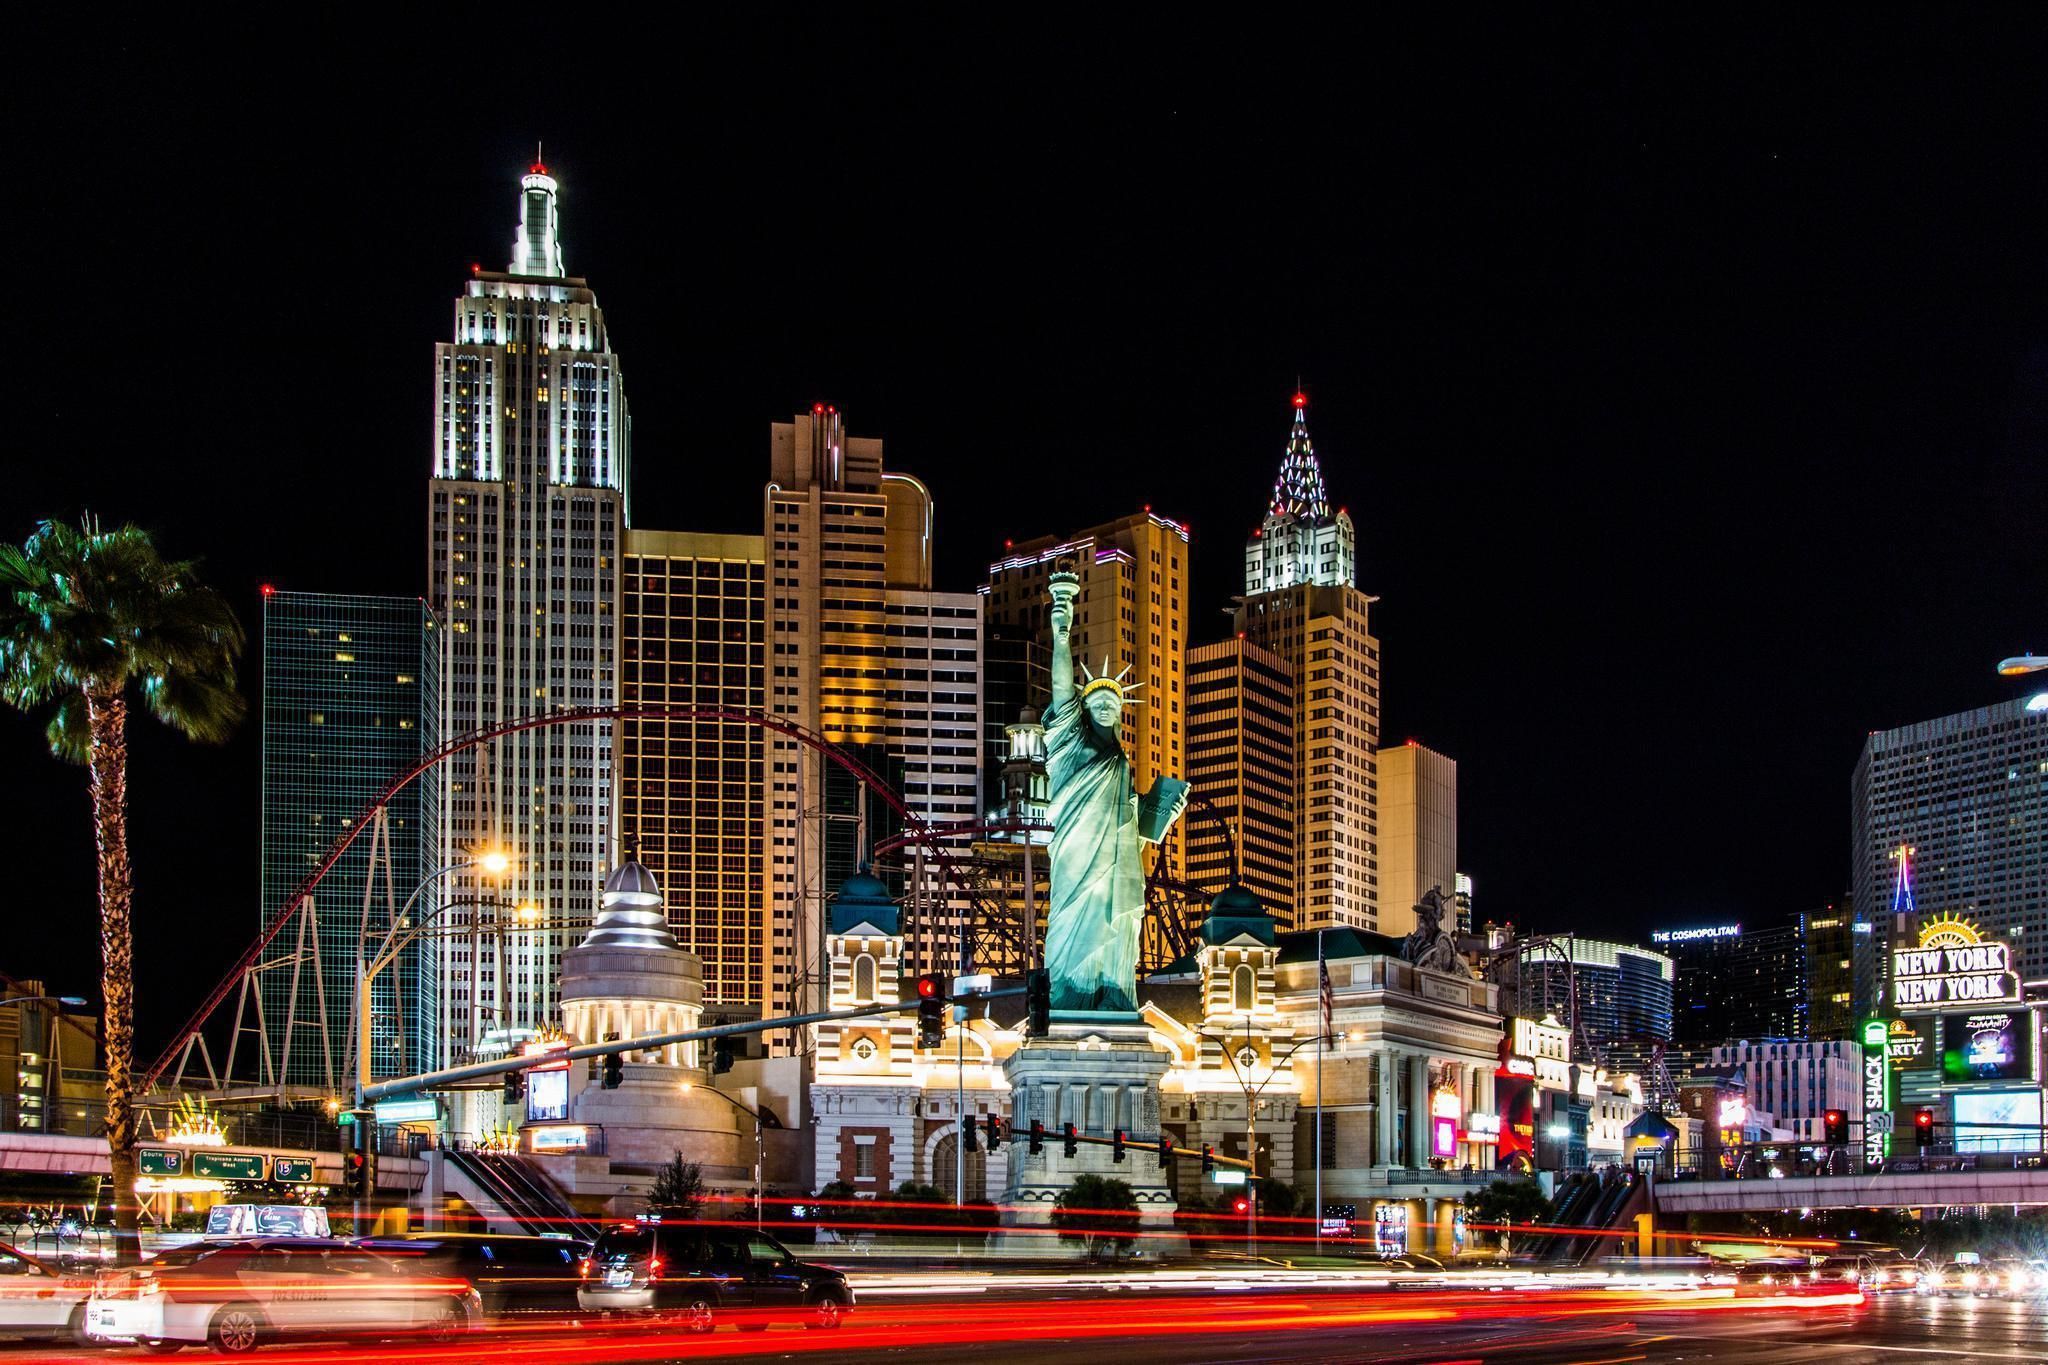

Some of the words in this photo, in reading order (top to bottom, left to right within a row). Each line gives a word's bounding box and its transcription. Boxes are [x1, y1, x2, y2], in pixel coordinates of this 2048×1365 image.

[1653, 933, 1670, 942] THE
[1672, 926, 1738, 940] COSMOPOLITAN
[1894, 950, 1942, 976] NEW
[1945, 946, 2004, 972] YORK
[1894, 979, 1943, 1003] NEW
[1945, 975, 2005, 1000] YORK
[1965, 1018, 2012, 1030] ZUMANITY
[1886, 1043, 1922, 1056] ARTY.
[1866, 1054, 1883, 1109] SHACK
[166, 1157, 177, 1166] 15
[278, 1164, 291, 1173] 15
